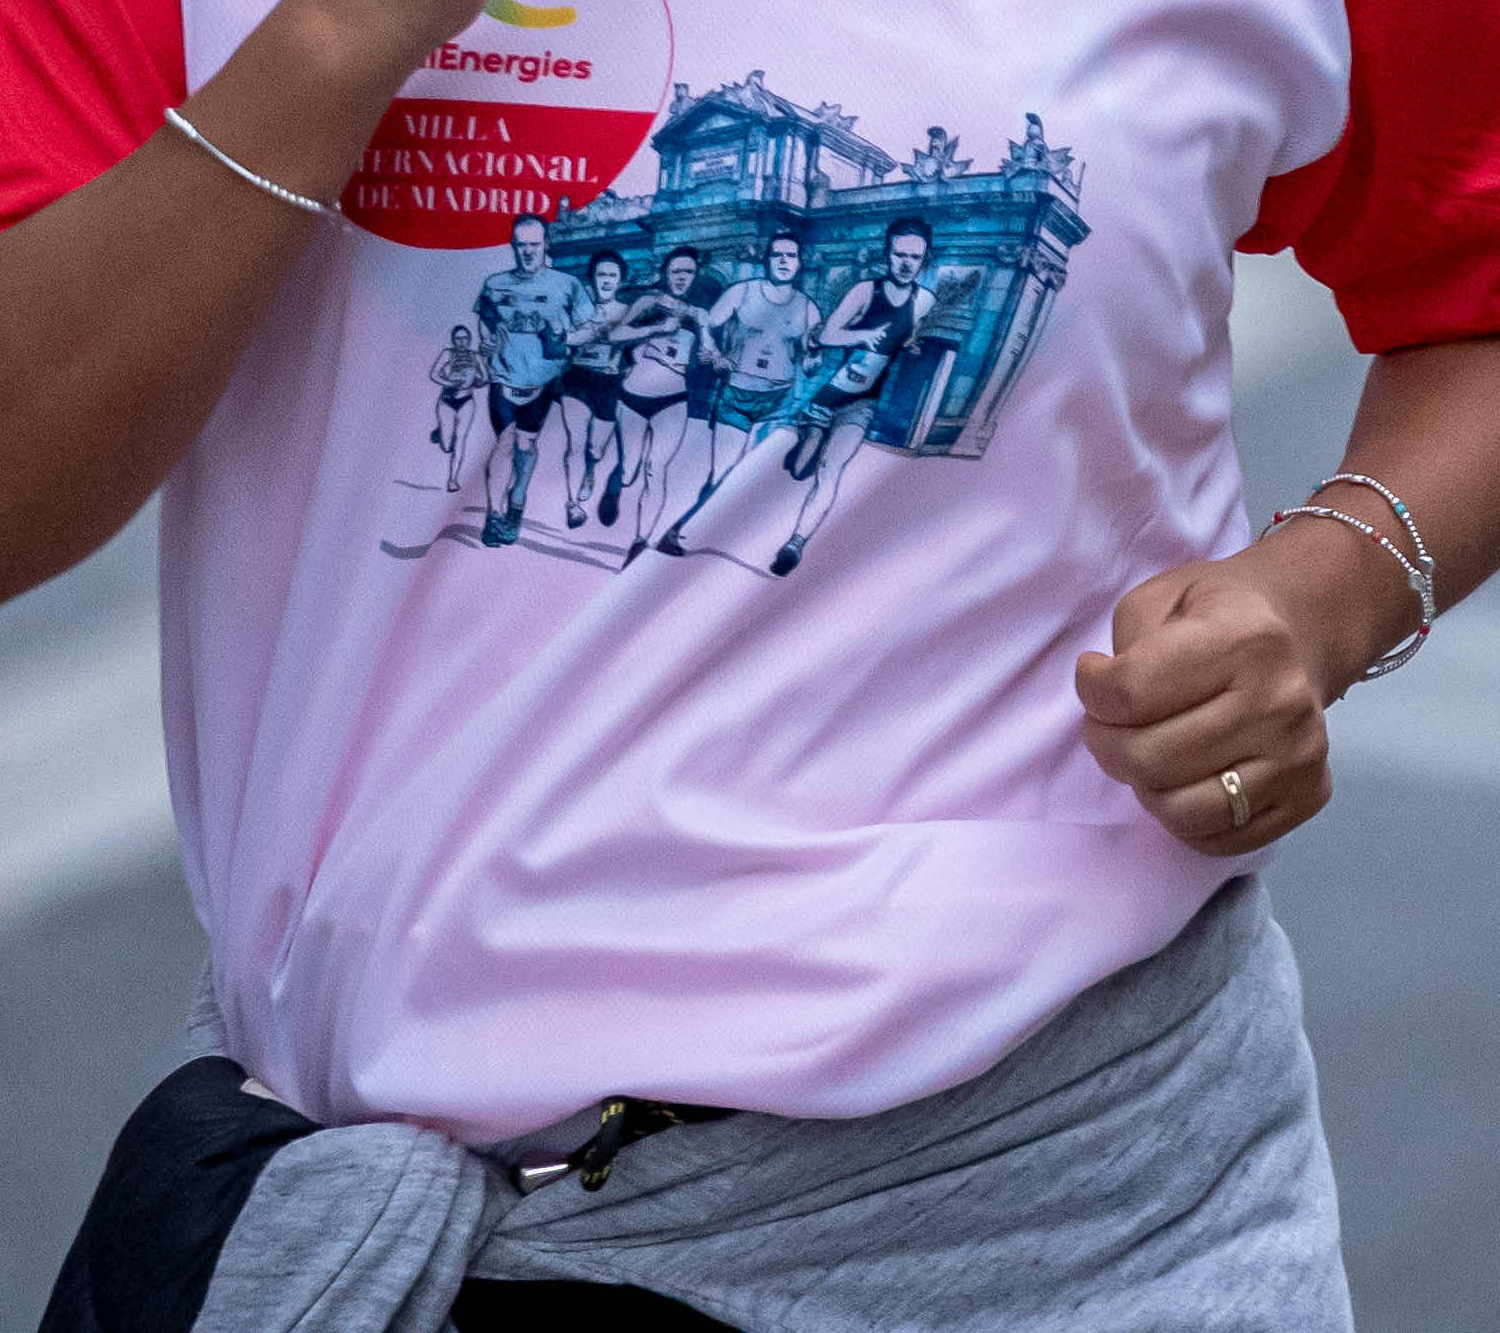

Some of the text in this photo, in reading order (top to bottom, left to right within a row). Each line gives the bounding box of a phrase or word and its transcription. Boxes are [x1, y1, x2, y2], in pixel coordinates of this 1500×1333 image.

[419, 42, 592, 82] lEnergies
[404, 113, 511, 143] MILLA
[357, 185, 551, 214] DE MADRID
